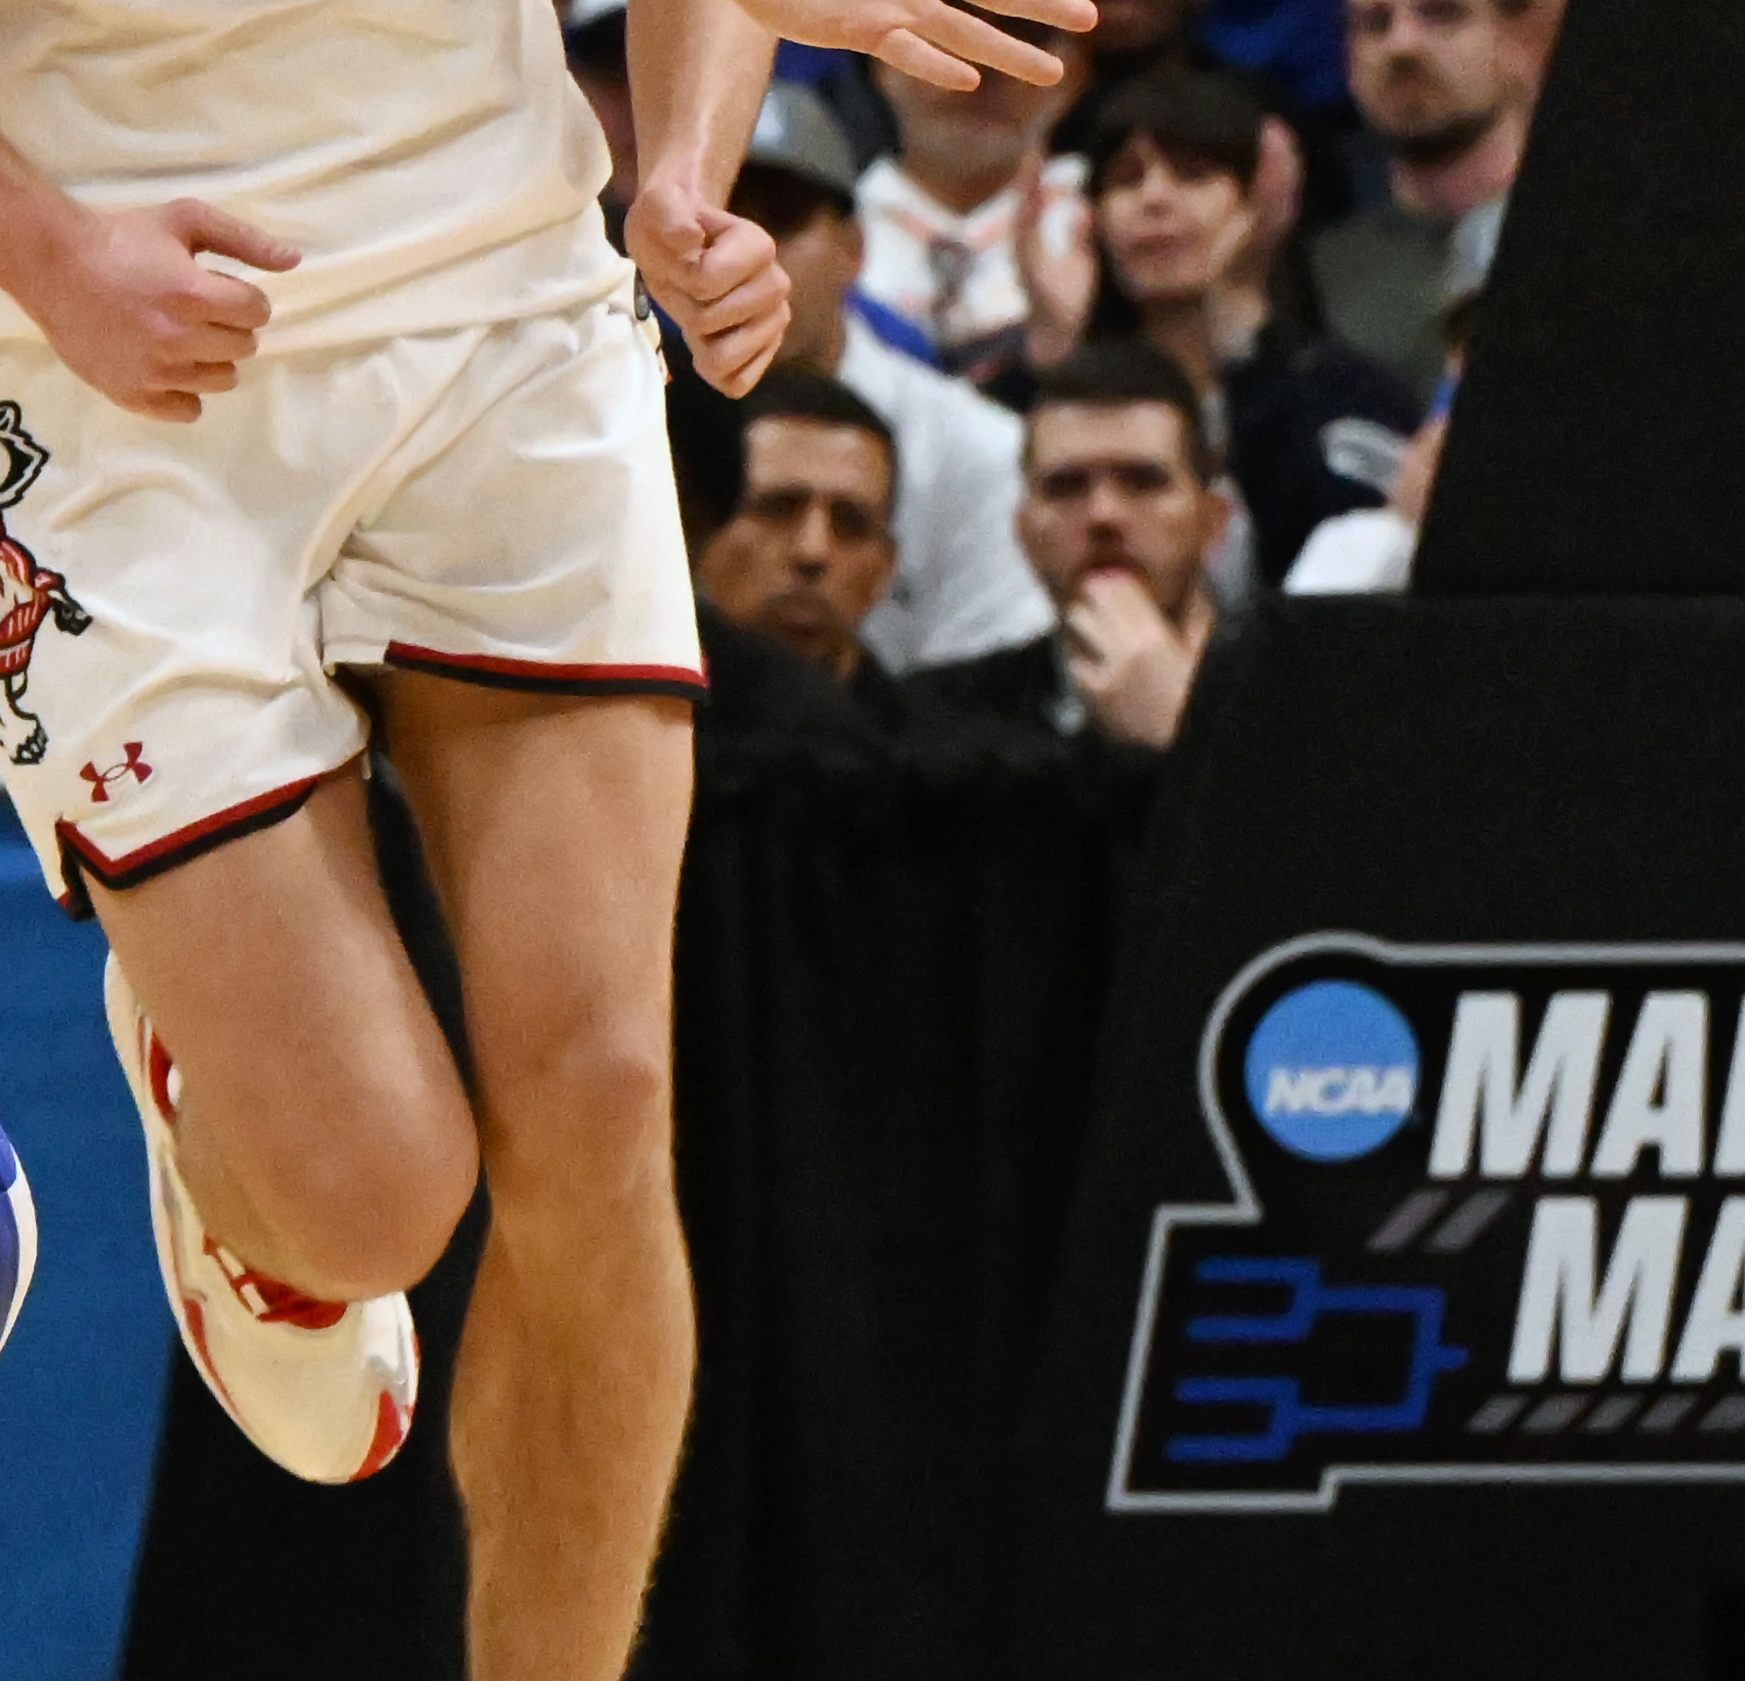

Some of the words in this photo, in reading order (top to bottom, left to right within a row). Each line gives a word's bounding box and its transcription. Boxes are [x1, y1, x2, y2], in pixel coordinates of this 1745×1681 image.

[1265, 1062, 1415, 1116] NCAA
[1427, 990, 1745, 1180] MA
[1508, 1194, 1745, 1384] MA
